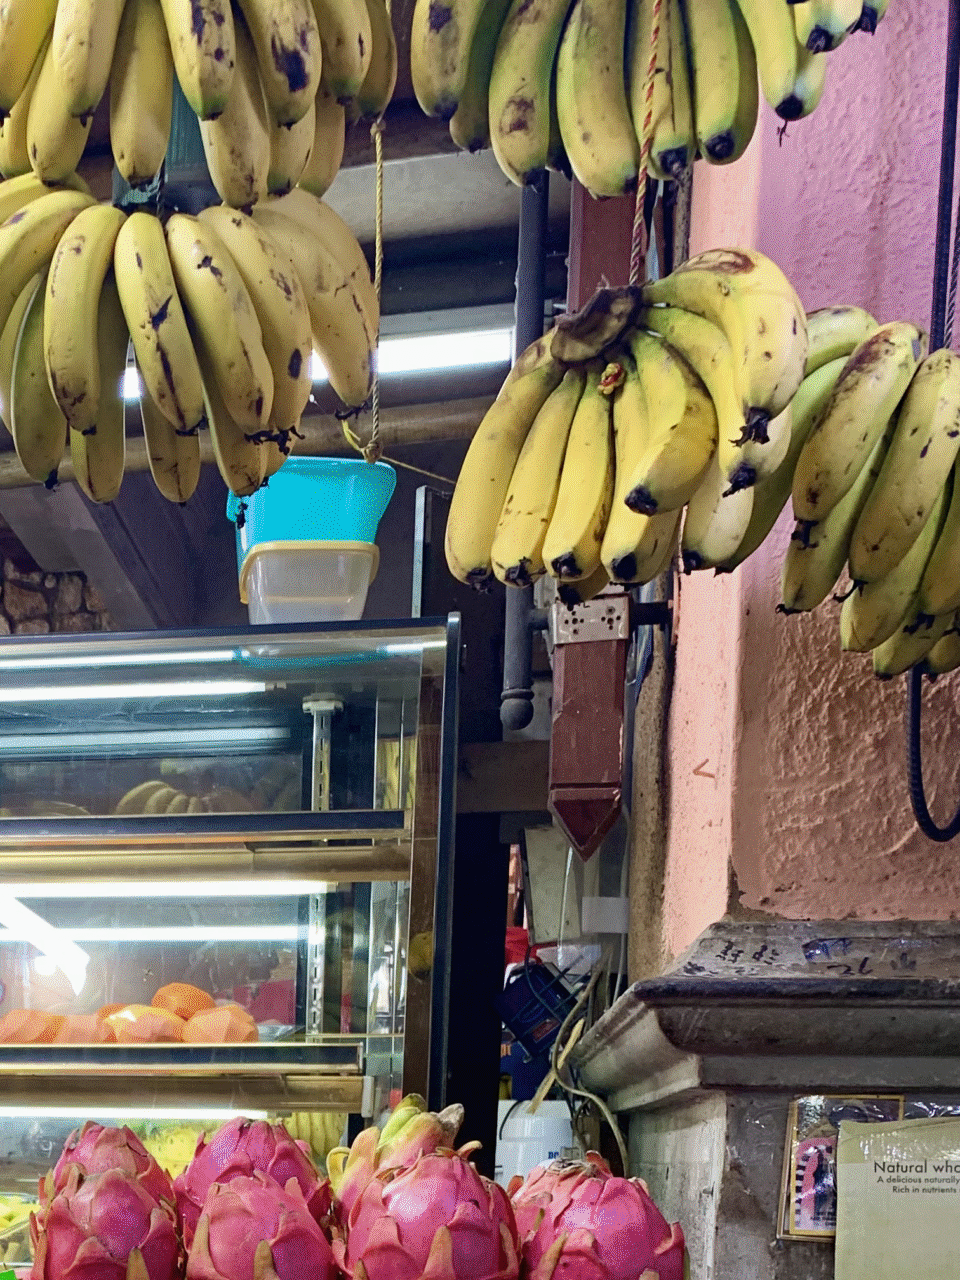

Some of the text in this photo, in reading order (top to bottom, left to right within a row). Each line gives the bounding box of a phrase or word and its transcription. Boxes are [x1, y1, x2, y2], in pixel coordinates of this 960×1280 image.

[874, 1160, 927, 1174] Natural
[876, 1176, 884, 1184] A
[886, 1176, 922, 1184] delicious
